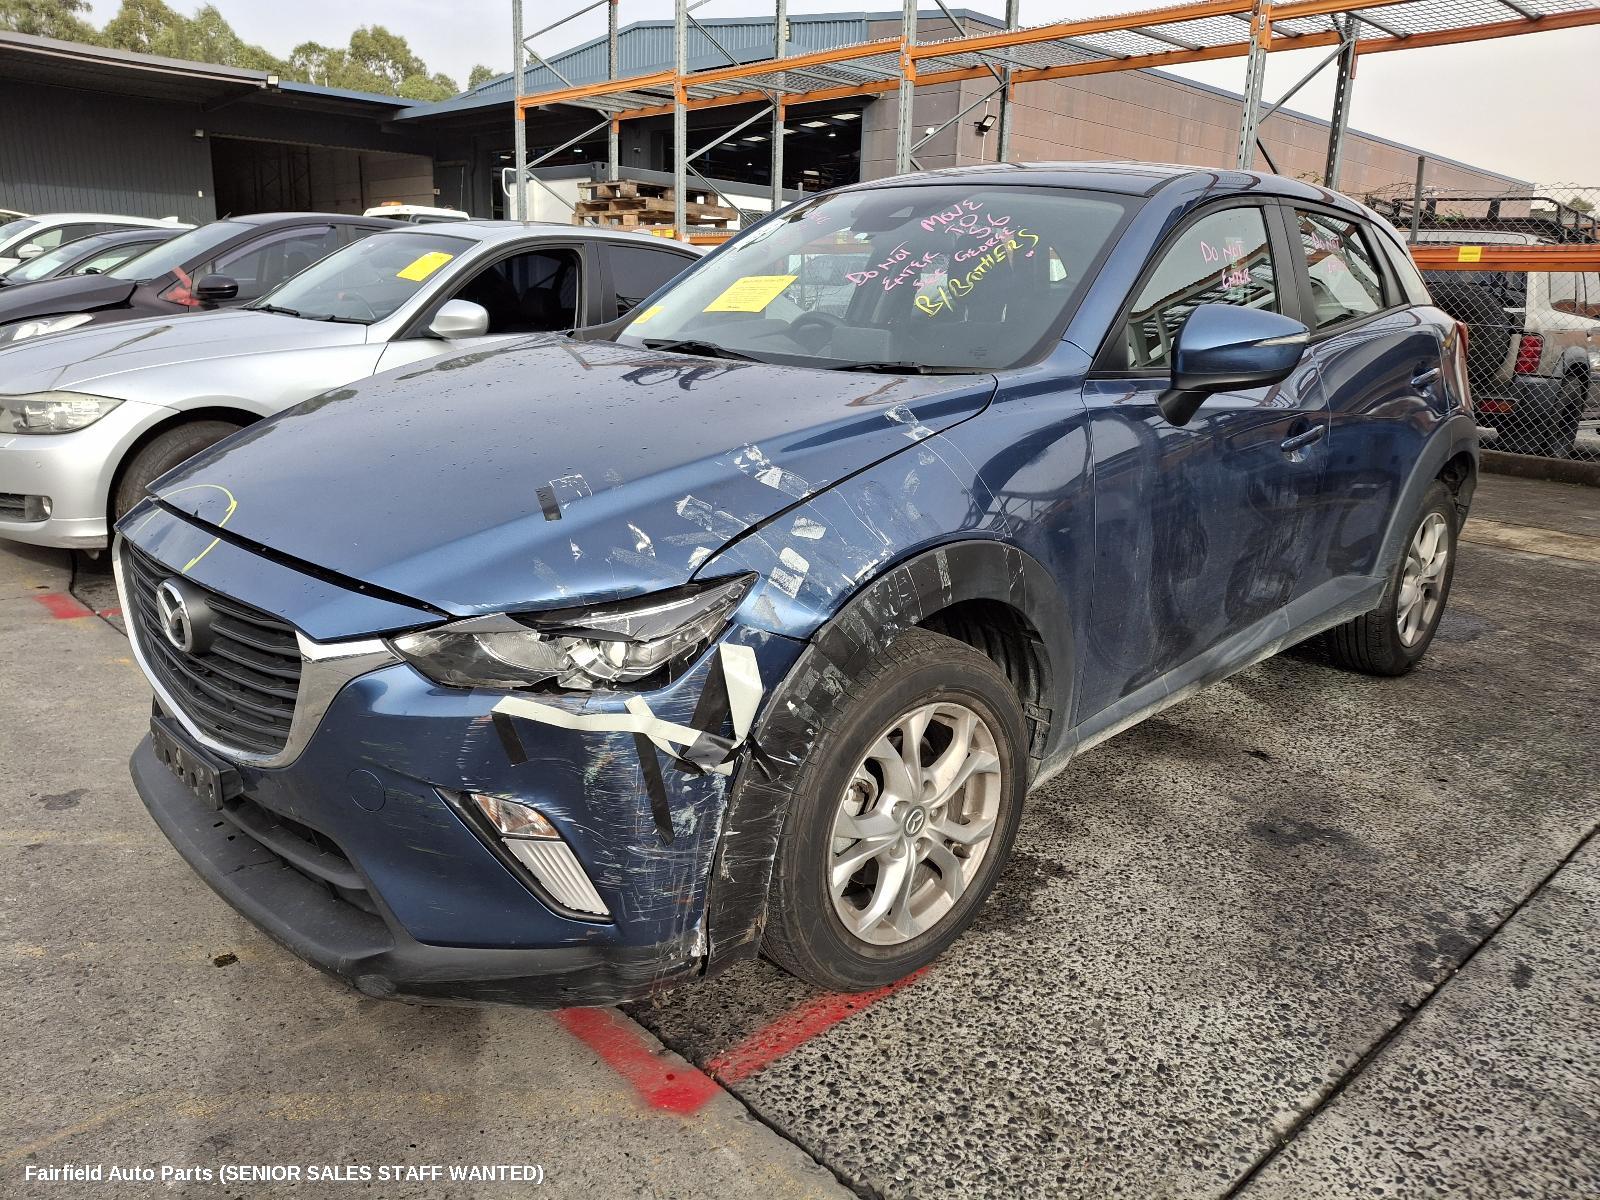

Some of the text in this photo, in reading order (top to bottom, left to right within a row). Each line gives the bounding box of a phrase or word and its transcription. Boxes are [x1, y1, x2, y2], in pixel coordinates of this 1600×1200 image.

[921, 199, 984, 232] MOVE
[845, 240, 912, 286] DO NOT
[882, 251, 940, 290] ENTER
[1200, 241, 1219, 264] DO
